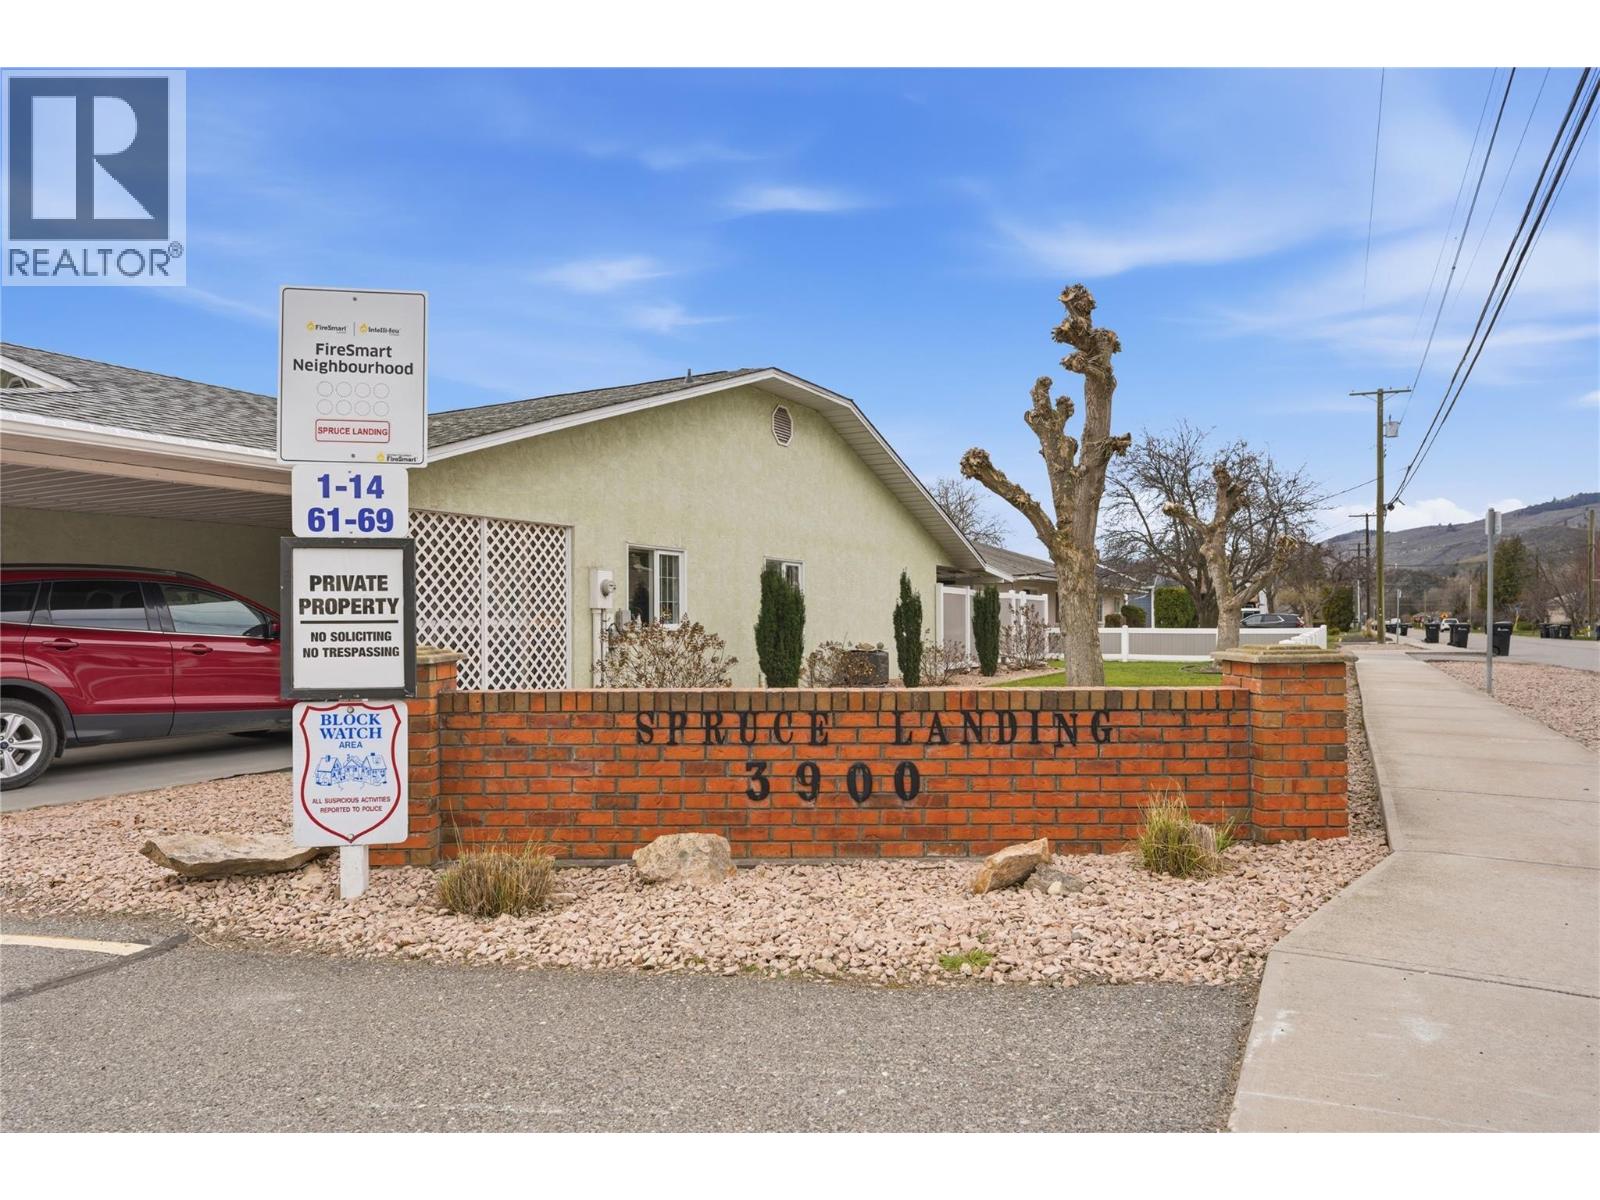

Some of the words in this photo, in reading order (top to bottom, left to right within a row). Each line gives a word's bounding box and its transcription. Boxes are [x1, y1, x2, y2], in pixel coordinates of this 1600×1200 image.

[316, 343, 392, 358] FireSmart
[293, 359, 414, 374] Neighbourhood
[318, 427, 350, 435] SPRUCE
[352, 428, 388, 436] LANDING
[318, 474, 384, 498] 1-14
[308, 507, 394, 532] 61-69
[310, 575, 388, 592] PRIVATE
[299, 598, 399, 615] PROPERTY
[310, 632, 326, 642] NO
[330, 631, 392, 642] SOLICITING
[303, 648, 319, 658] NO
[322, 647, 400, 658] TRESPASSING
[321, 714, 380, 726] BLOCK
[320, 728, 382, 739] WATCH
[635, 711, 829, 746] SPRUCE
[891, 710, 1114, 747] LANDING
[745, 761, 921, 802] 3900
